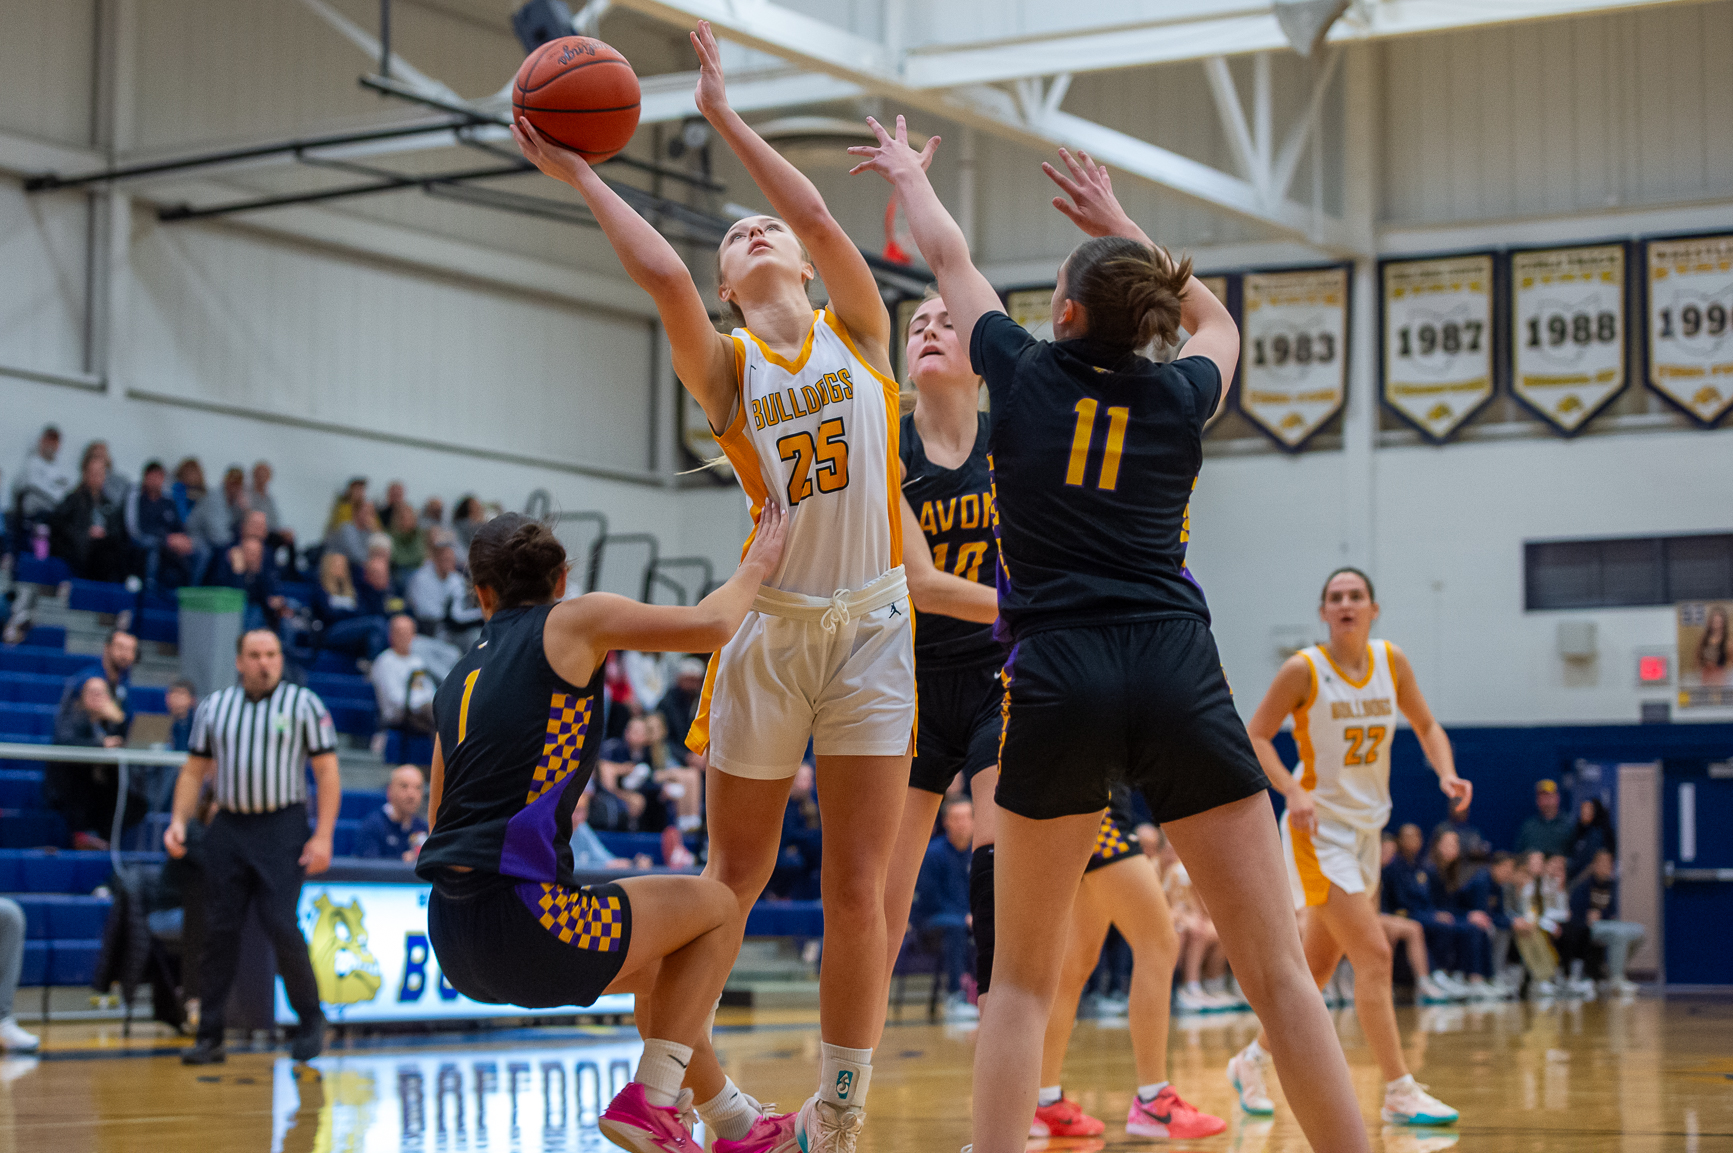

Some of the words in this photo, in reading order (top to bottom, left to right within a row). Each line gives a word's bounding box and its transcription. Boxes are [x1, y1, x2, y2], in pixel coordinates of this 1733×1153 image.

[1397, 319, 1483, 357] 1987
[1527, 310, 1616, 349] 1988
[1658, 303, 1733, 339] 199
[1253, 331, 1336, 368] 1983
[751, 368, 854, 431] BULLDOGS
[775, 416, 850, 507] 25
[1063, 396, 1129, 491] 11
[932, 541, 989, 584] 10
[456, 666, 482, 747] 1
[1343, 726, 1387, 767] 22
